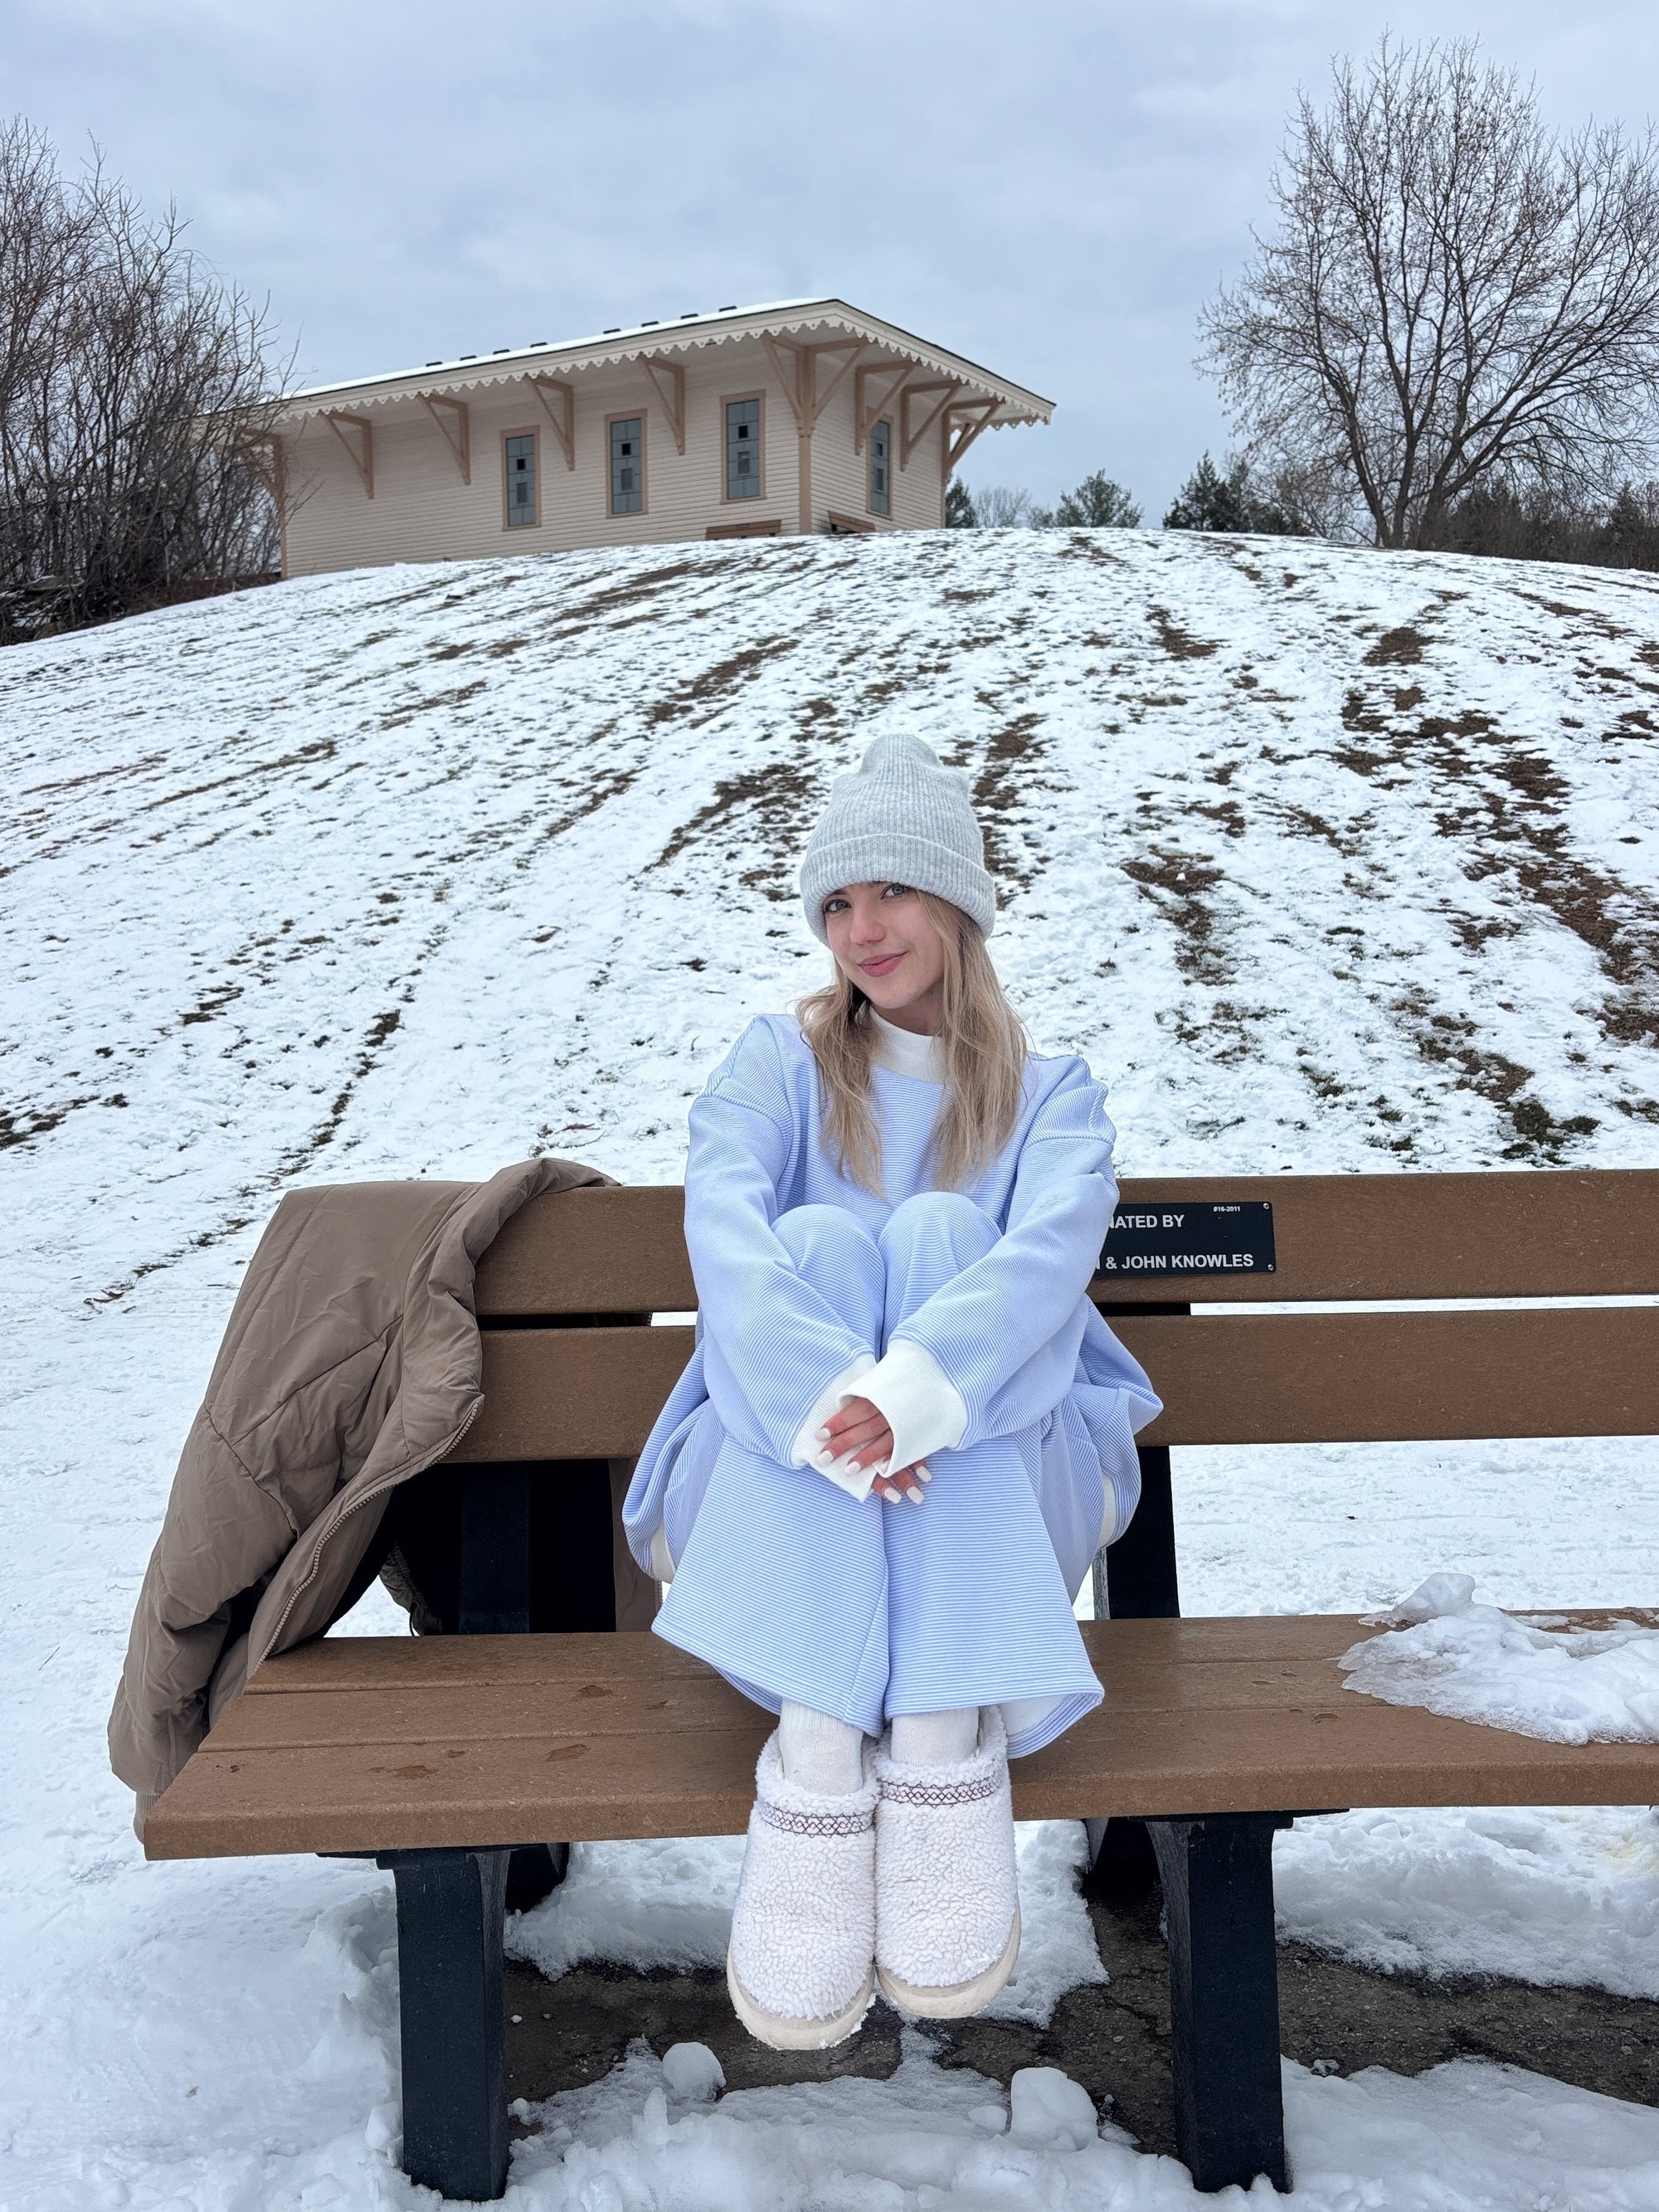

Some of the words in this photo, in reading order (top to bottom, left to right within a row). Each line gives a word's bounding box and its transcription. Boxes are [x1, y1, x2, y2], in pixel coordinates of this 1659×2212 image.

[1162, 1214, 1185, 1228] BY
[1105, 1256, 1117, 1270] &
[1121, 1255, 1167, 1270] JOHN
[1171, 1253, 1254, 1269] KNOWLES
